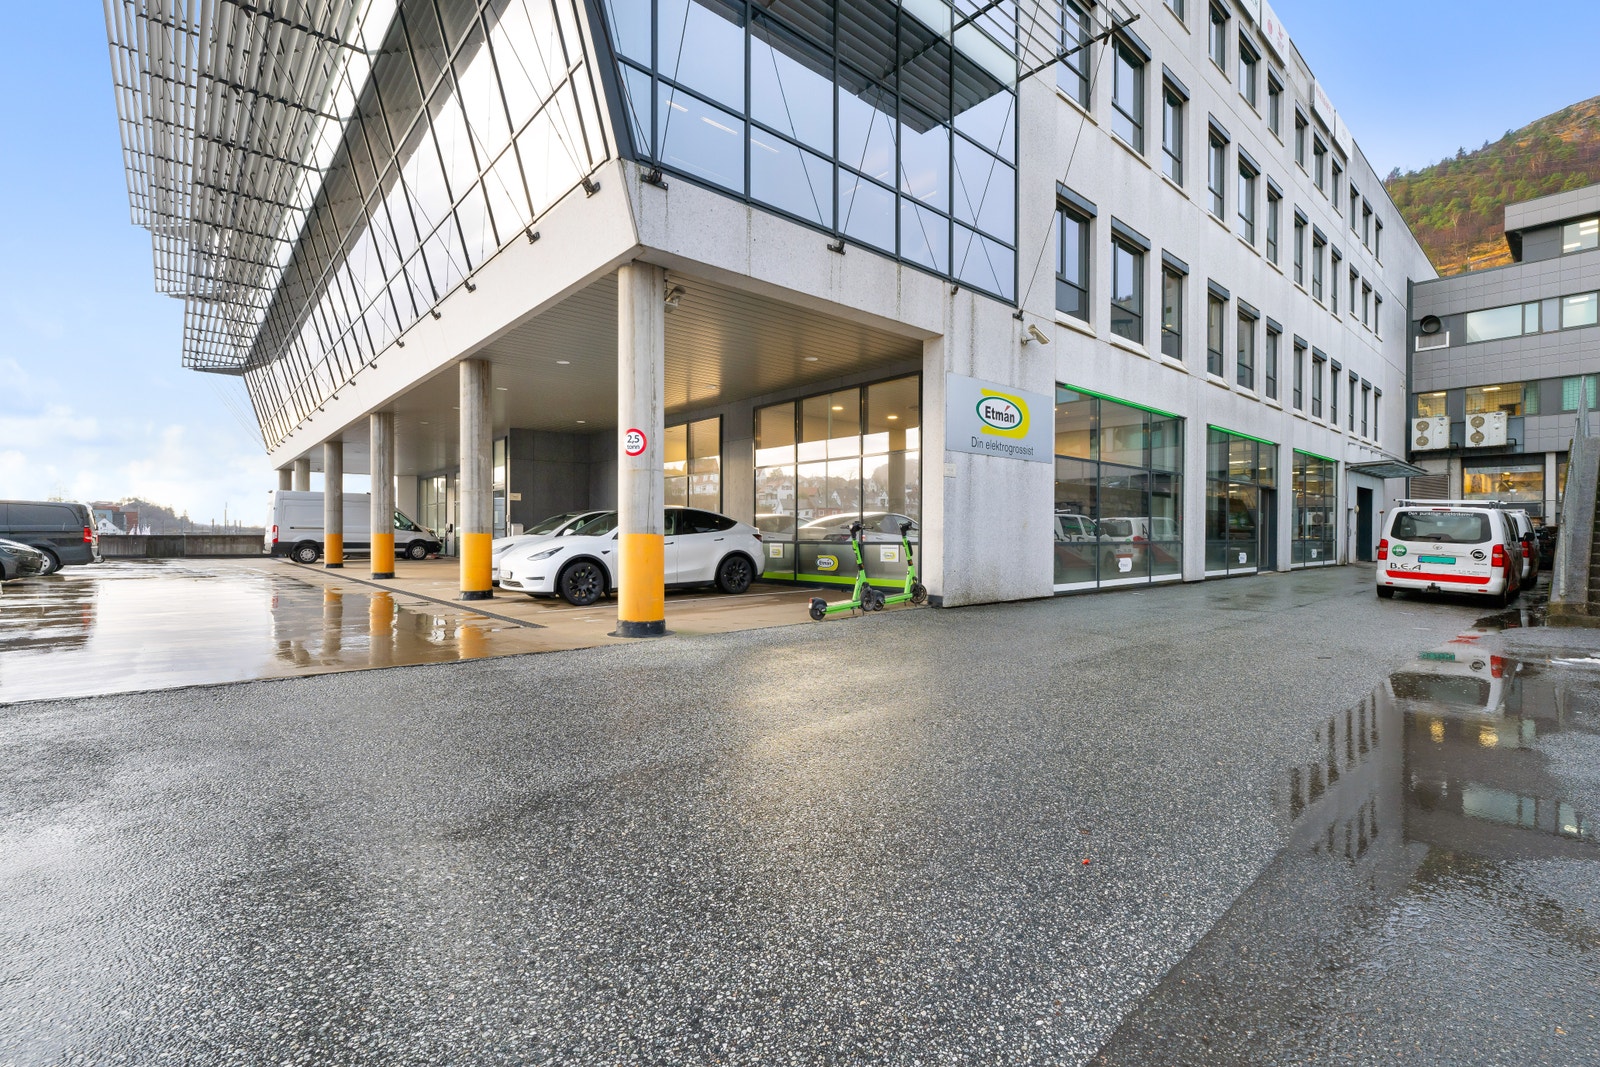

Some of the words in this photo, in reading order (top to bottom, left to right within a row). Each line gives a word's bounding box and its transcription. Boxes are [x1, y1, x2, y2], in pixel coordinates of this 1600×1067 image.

[985, 405, 1015, 423] Etmán
[627, 434, 640, 444] 2,5
[971, 436, 984, 449] Din
[985, 440, 1034, 455] elektrogrossist
